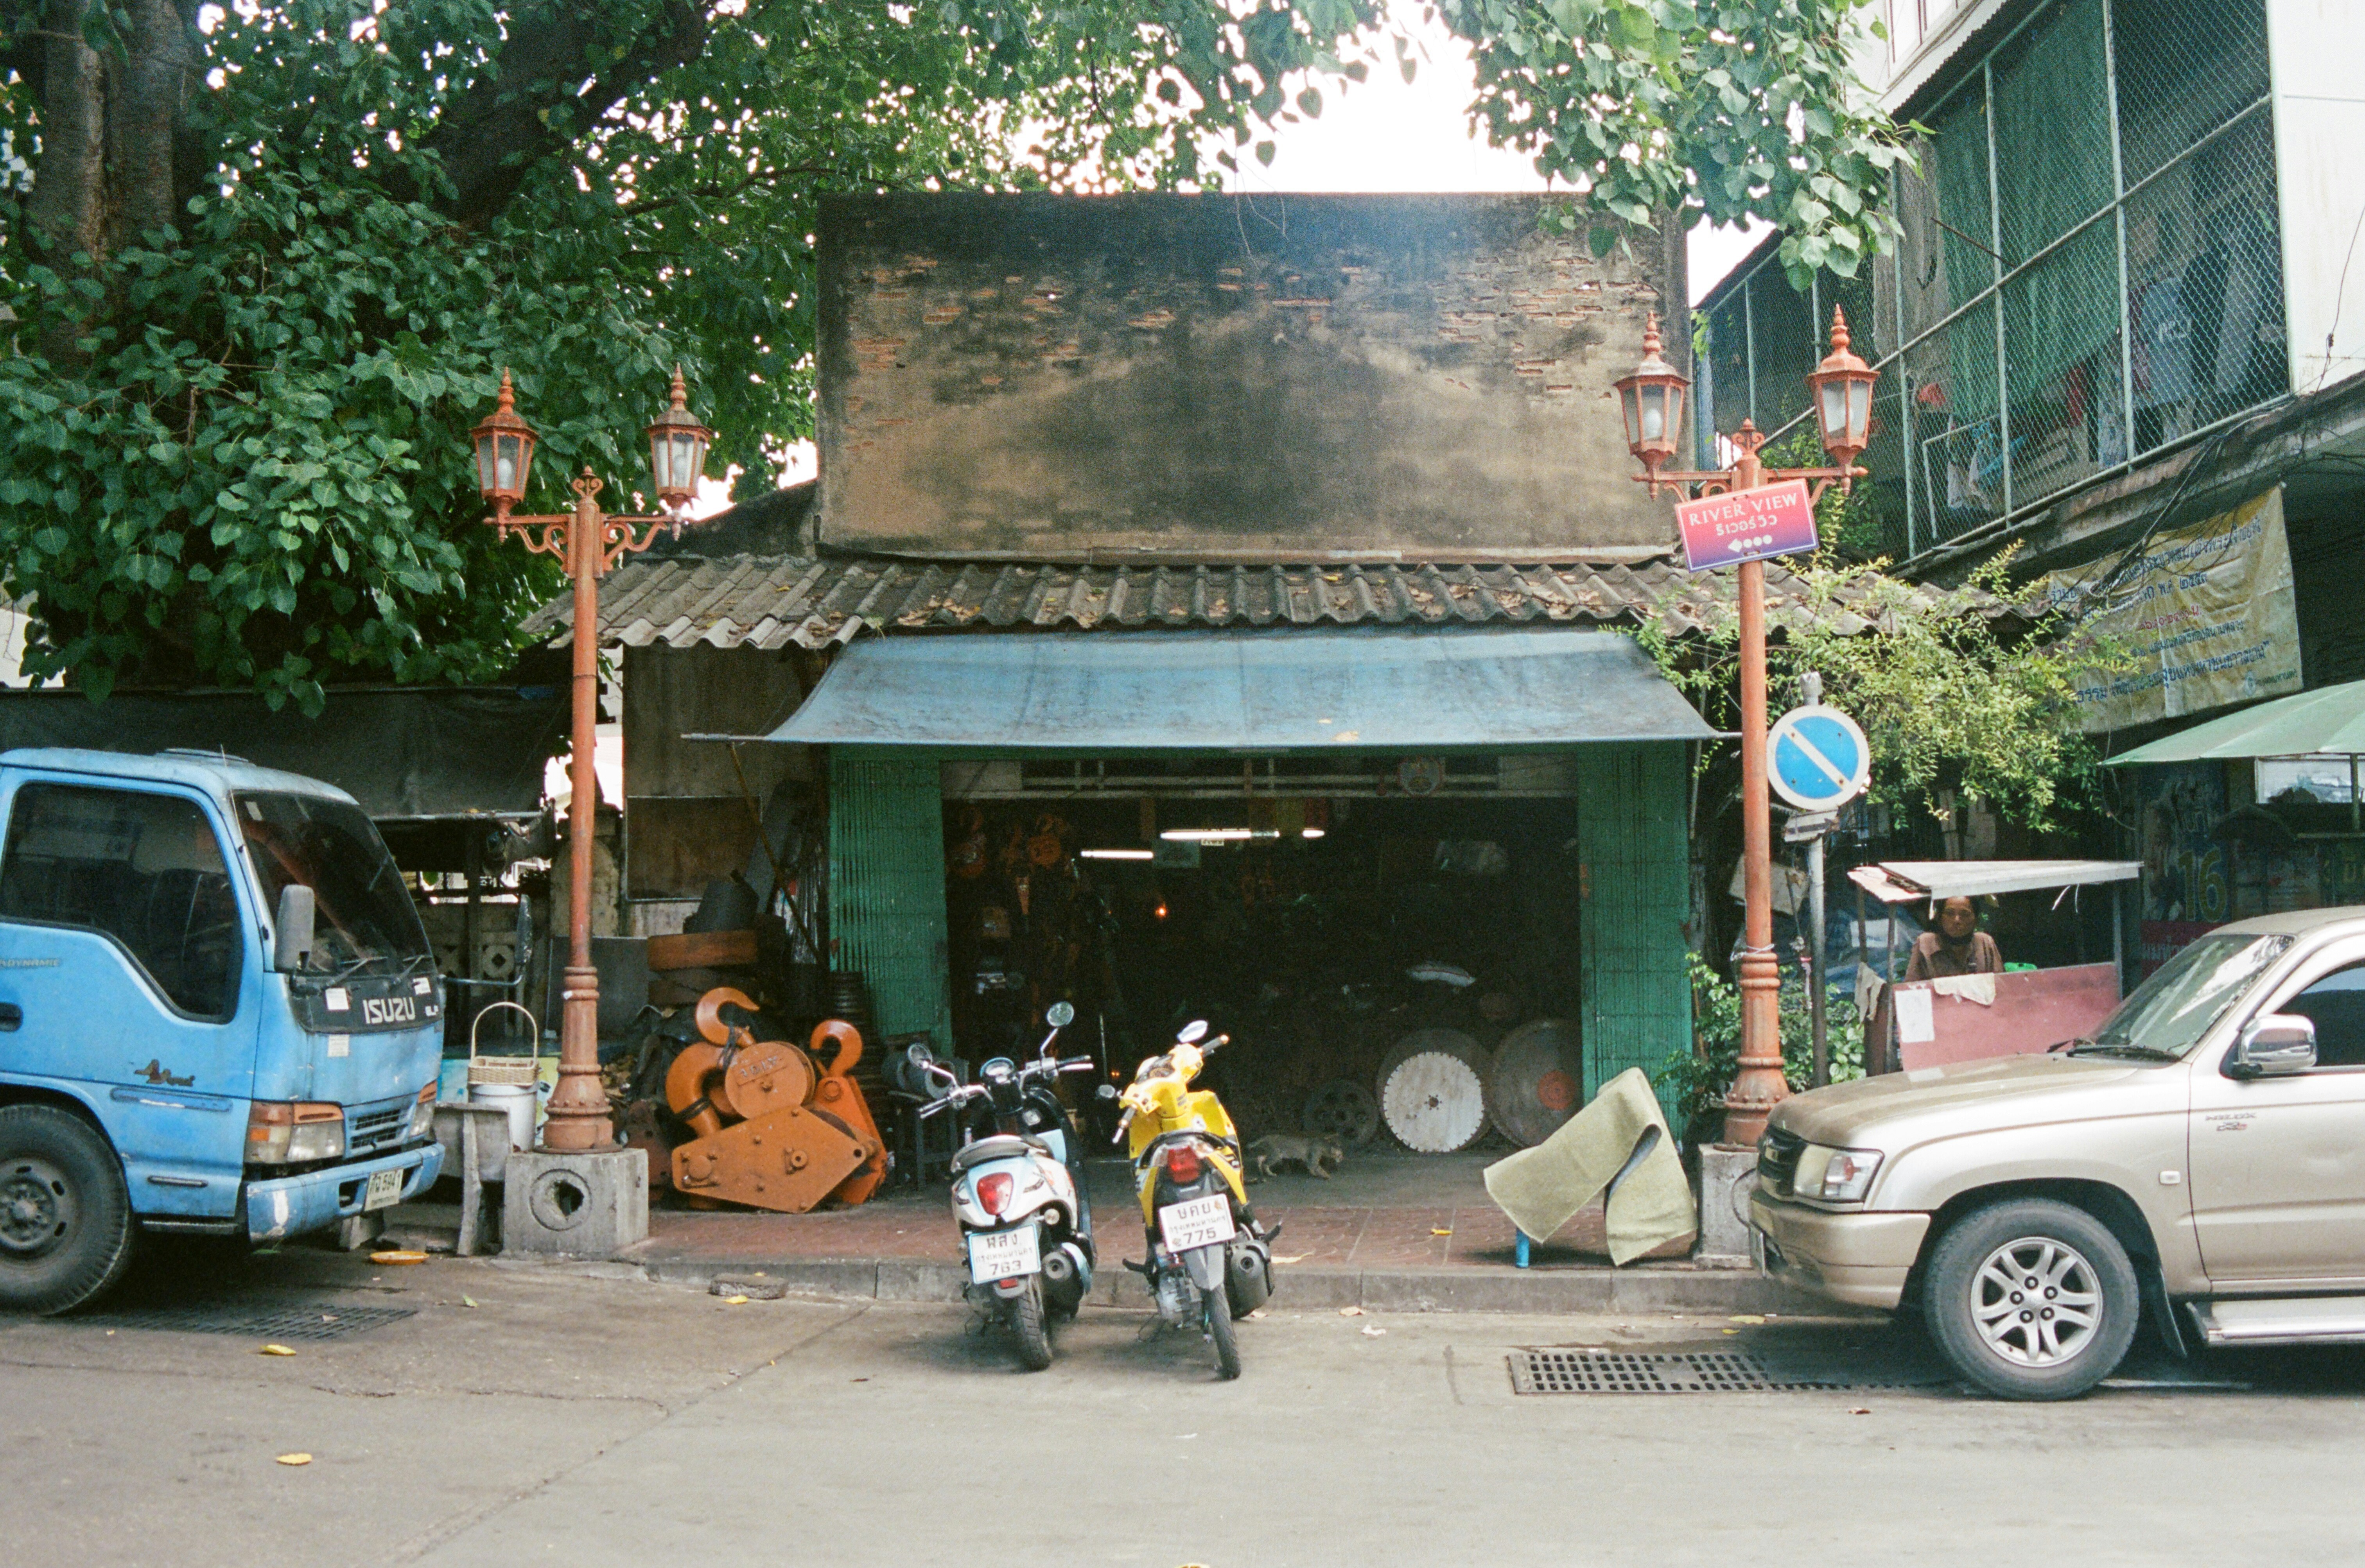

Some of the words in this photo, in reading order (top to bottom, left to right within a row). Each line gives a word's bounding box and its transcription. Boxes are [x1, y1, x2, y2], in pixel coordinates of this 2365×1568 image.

[1690, 505, 1745, 526] RIVER
[1751, 493, 1797, 513] VIEW
[2177, 844, 2226, 923] 16
[363, 997, 416, 1024] ISUZU
[1183, 1227, 1217, 1244] 775
[975, 1247, 1033, 1263] กรุงเทพมหานคร
[989, 1260, 1021, 1276] 763
